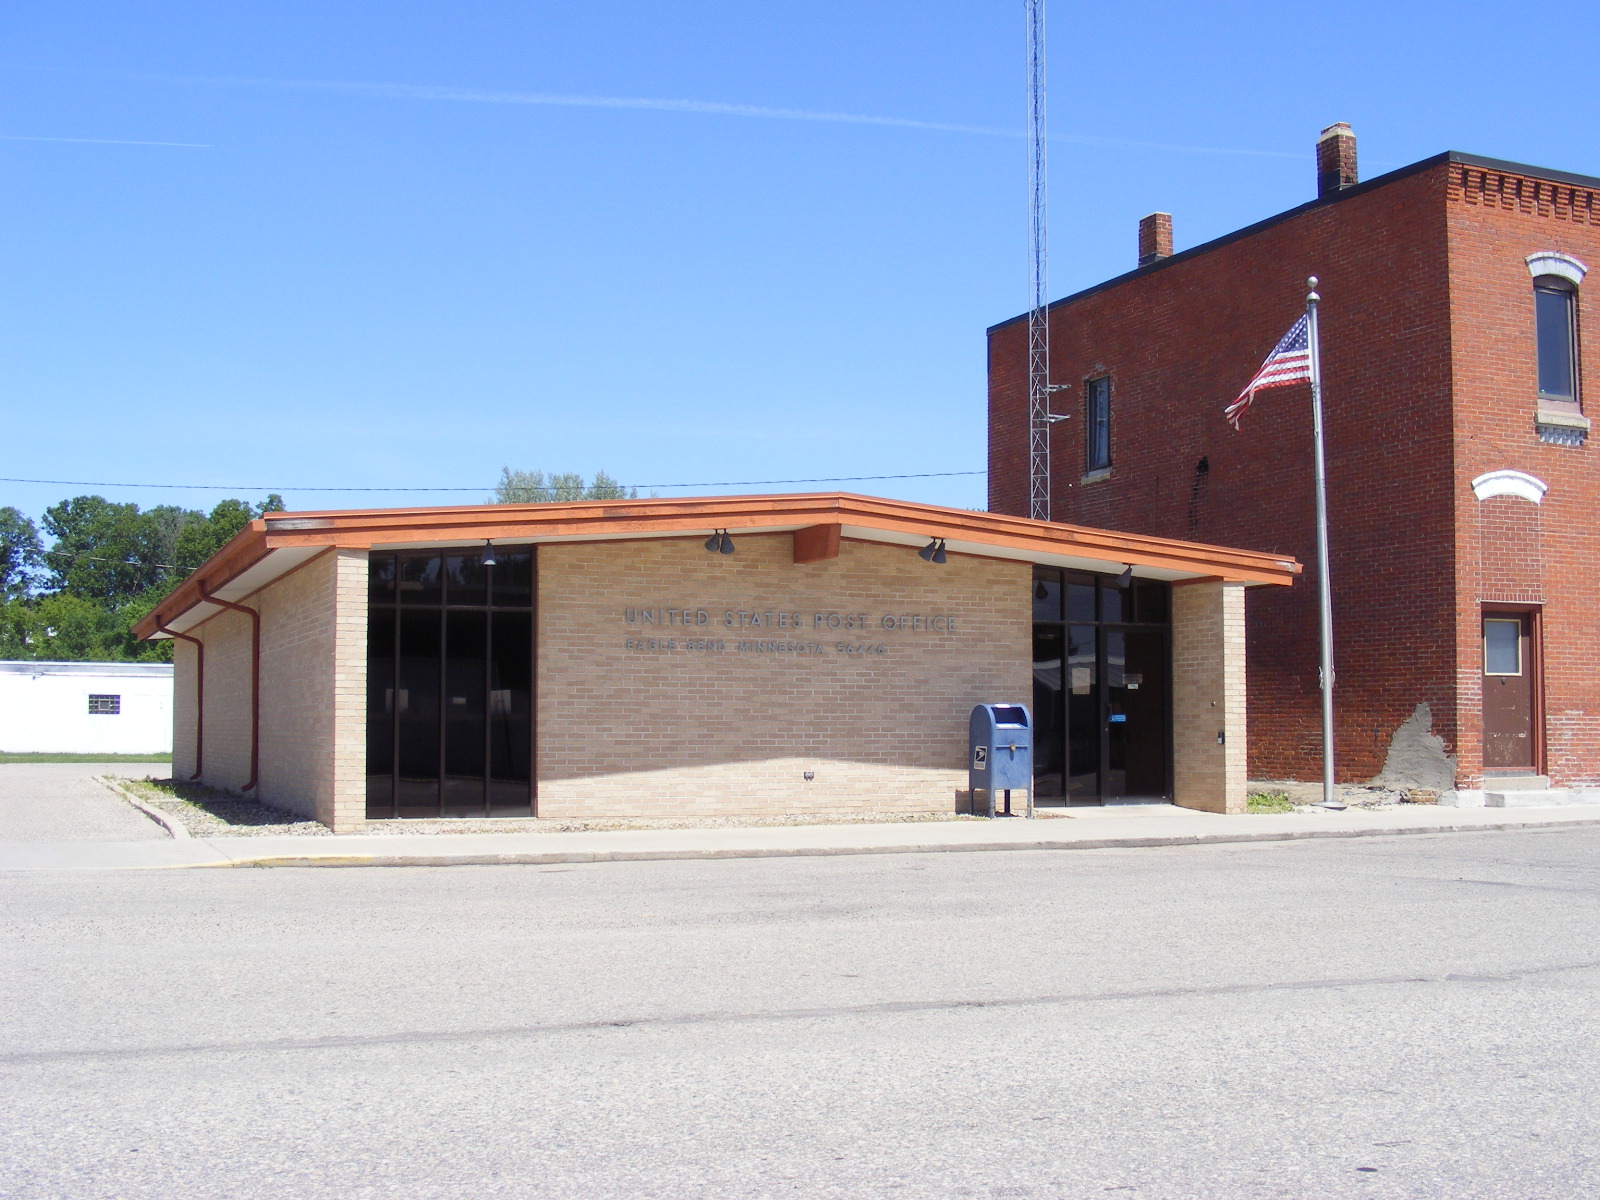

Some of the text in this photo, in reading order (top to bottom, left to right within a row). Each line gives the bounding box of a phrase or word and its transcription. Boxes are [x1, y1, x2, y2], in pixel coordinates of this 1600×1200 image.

[625, 608, 957, 632] UNITED STATES POST OFFICE
[626, 639, 885, 656] EAGLE BEND MINNESOTA 56446
